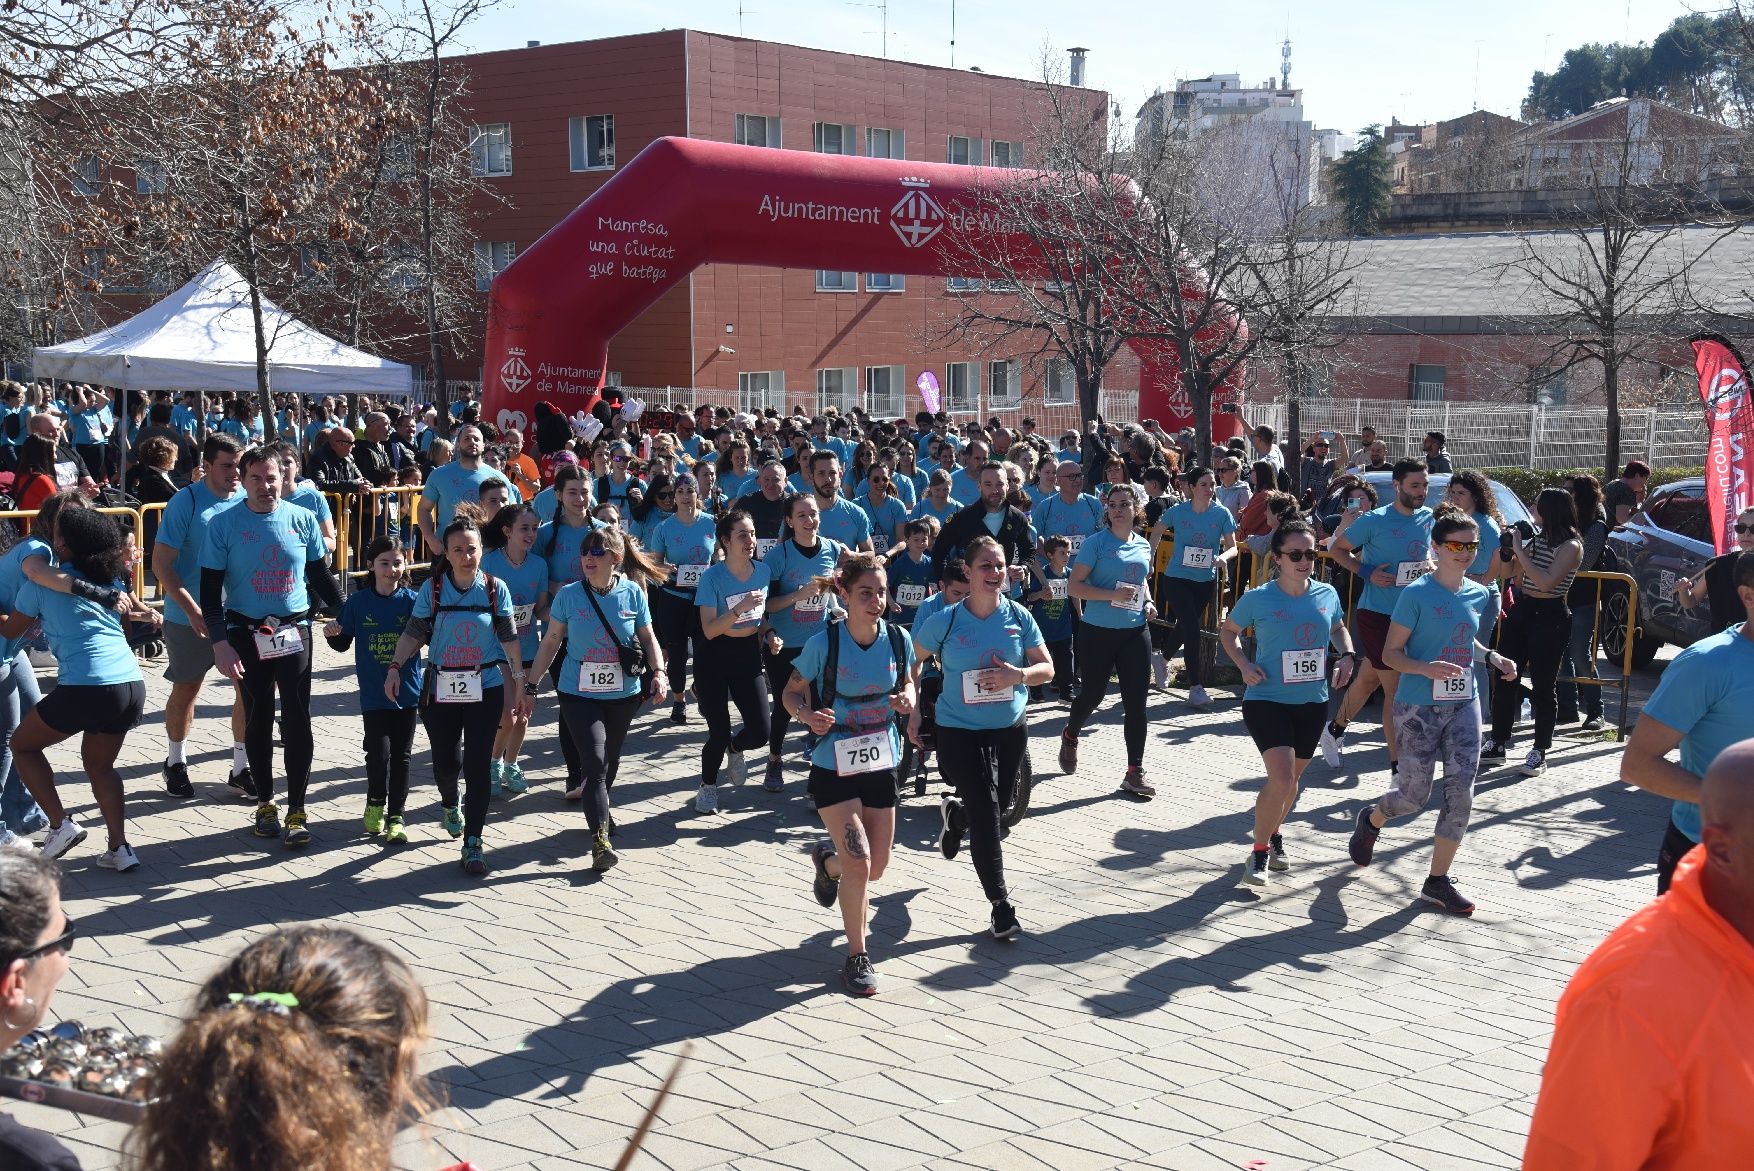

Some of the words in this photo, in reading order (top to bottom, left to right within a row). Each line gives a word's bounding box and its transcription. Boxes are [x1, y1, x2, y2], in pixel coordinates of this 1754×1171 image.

[758, 194, 881, 225] Ajuntament
[598, 216, 669, 238] Manresa,
[589, 240, 618, 254] una
[625, 239, 675, 259] ciutat
[588, 261, 614, 279] que
[622, 261, 667, 284] batega
[536, 379, 553, 392] de
[556, 380, 599, 396] Manresa
[1190, 553, 1206, 563] 157
[1405, 568, 1422, 580] 158
[900, 591, 922, 601] 1012
[270, 635, 286, 649] 17
[1292, 660, 1317, 673] 156
[589, 672, 615, 685] 182
[449, 681, 468, 694] 12
[1444, 679, 1466, 692] 155
[847, 746, 880, 766] 750
